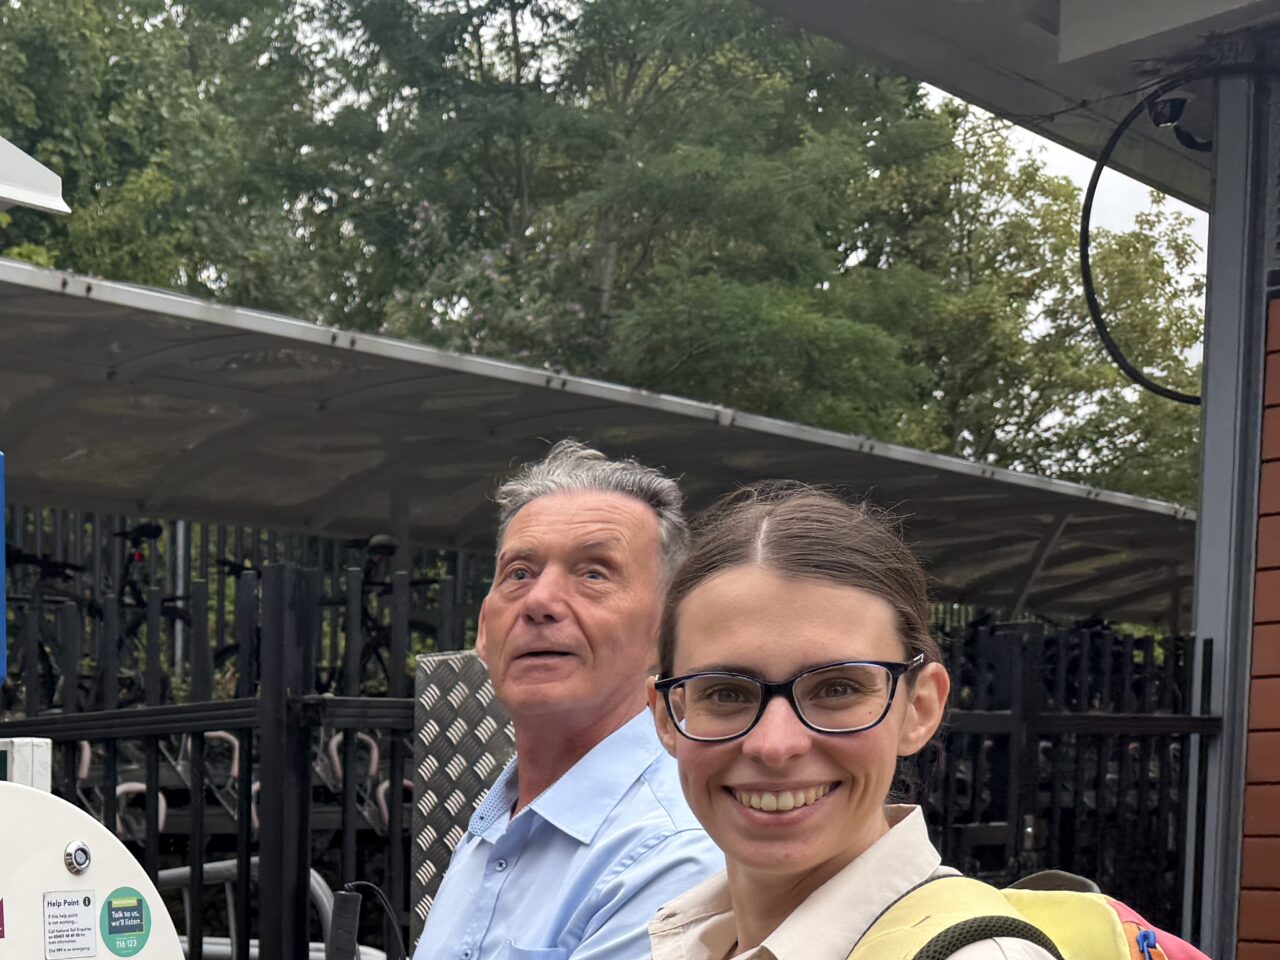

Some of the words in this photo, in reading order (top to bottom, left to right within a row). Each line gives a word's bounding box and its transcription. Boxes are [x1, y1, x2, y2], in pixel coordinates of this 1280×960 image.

[47, 900, 62, 909] Help
[63, 899, 79, 907] Point
[111, 919, 124, 927] we'll
[127, 939, 137, 948] 123
